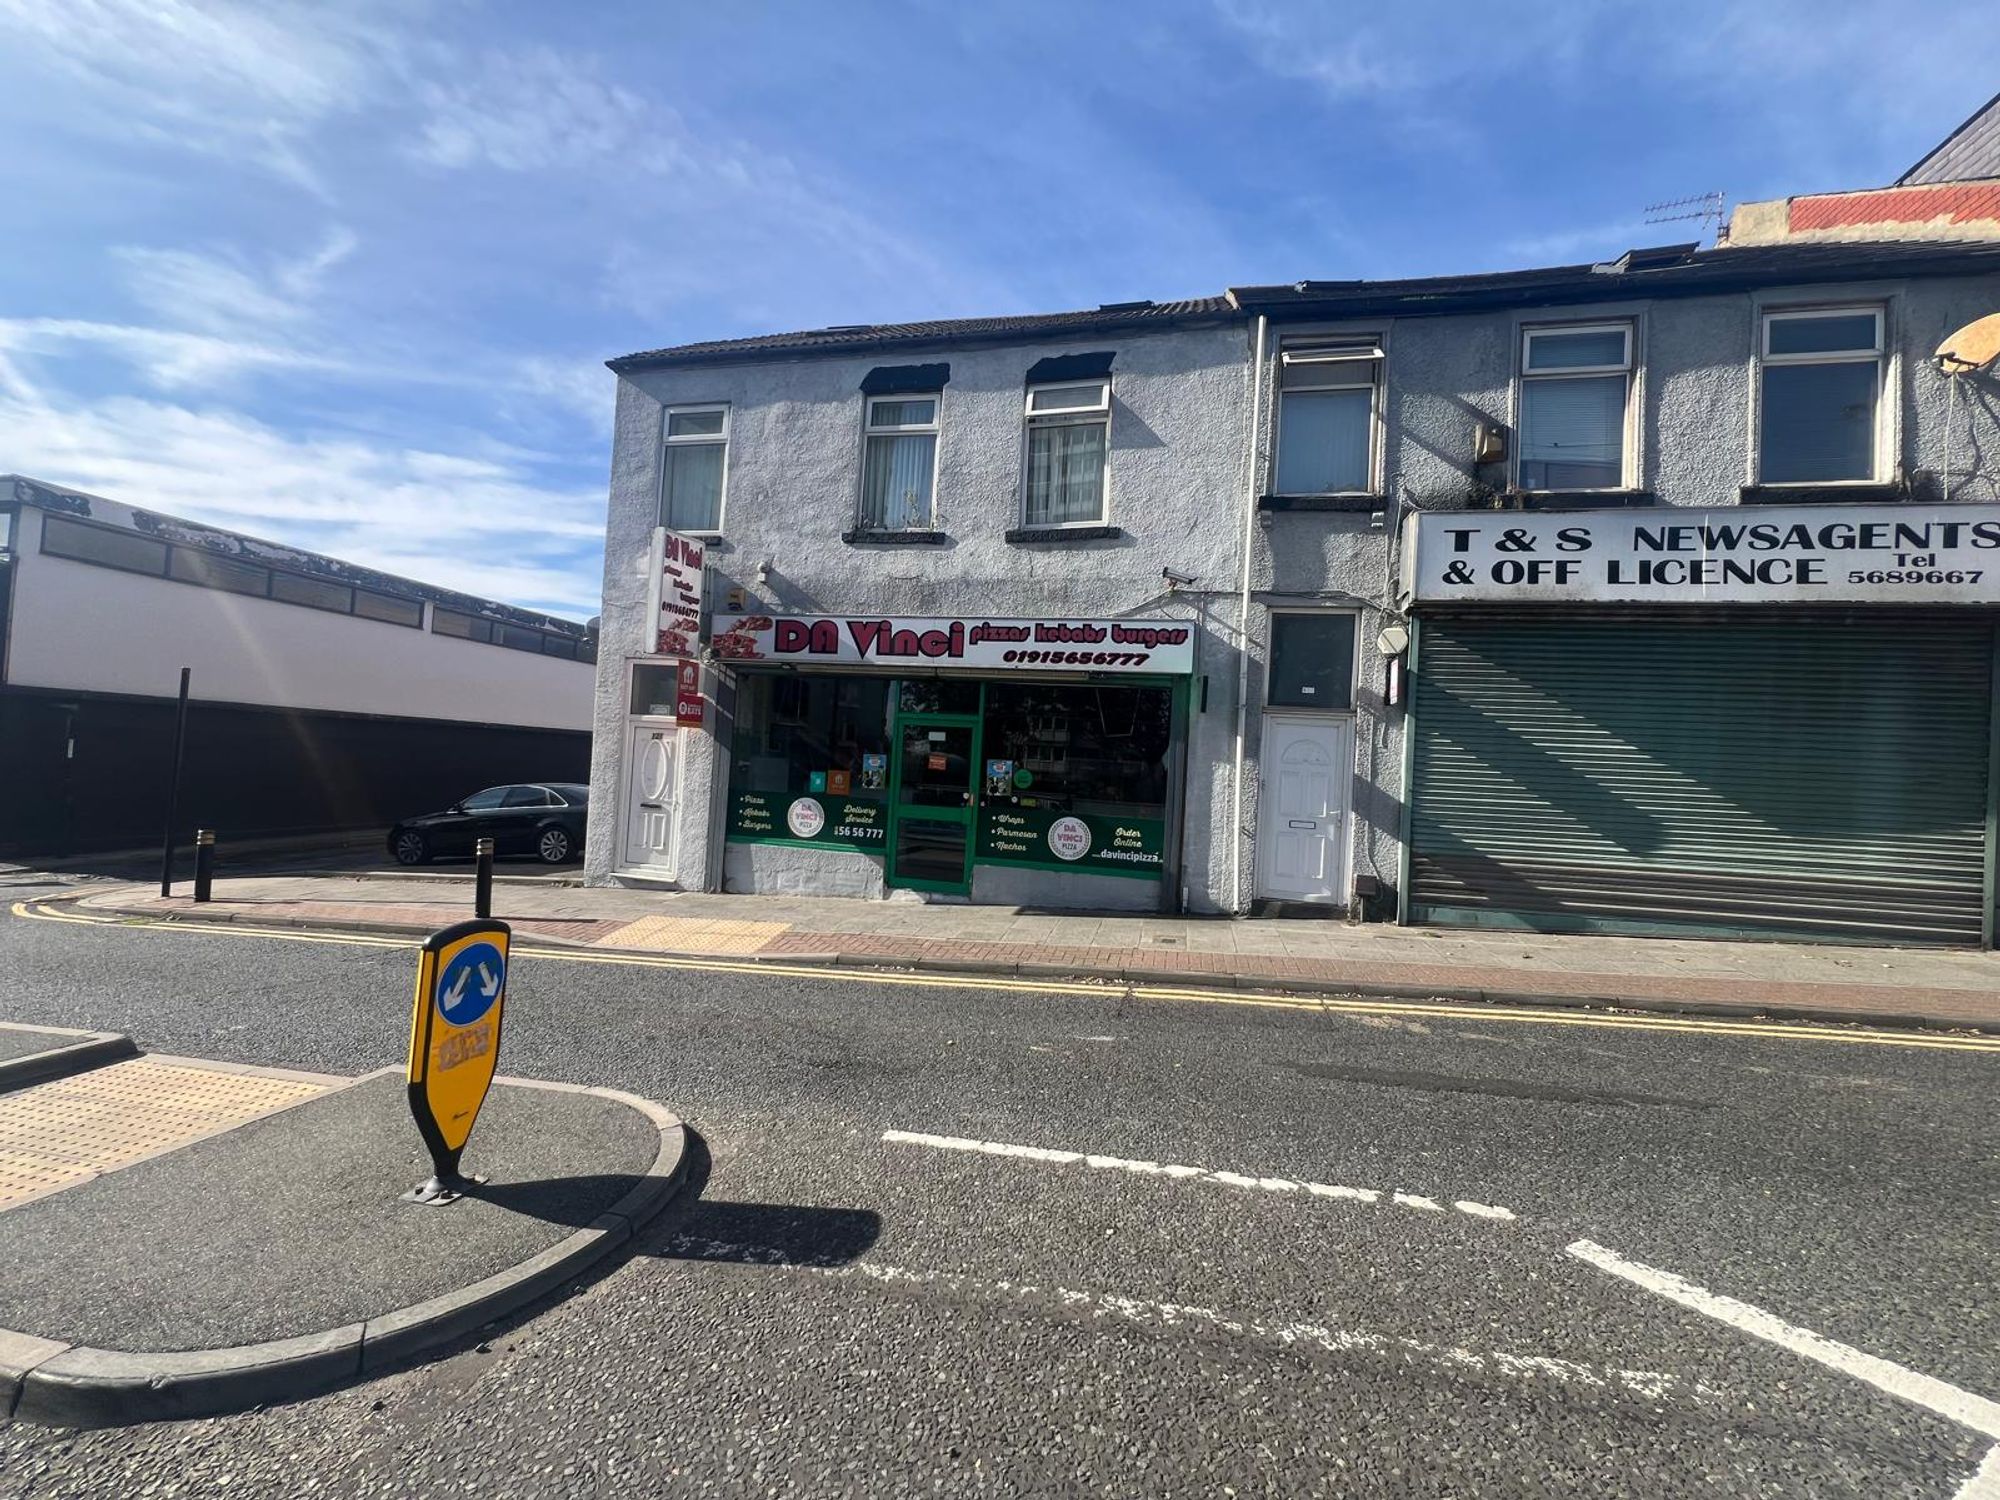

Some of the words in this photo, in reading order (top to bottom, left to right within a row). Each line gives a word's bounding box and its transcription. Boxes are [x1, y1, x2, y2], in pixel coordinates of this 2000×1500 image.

[1443, 529, 1481, 552] T
[1495, 528, 1537, 552] &
[1555, 528, 1592, 551] S
[1634, 522, 2000, 551] NEWSAGENTS
[1892, 553, 1935, 568] Tel
[1442, 559, 1475, 585] &
[1491, 559, 1582, 585] OFF
[1607, 558, 1828, 585] LICENCE
[1848, 570, 1984, 584] 5689667
[774, 619, 838, 654] DA
[846, 619, 965, 660] Vinci
[969, 622, 1030, 645] pizzas
[1034, 623, 1107, 643] kebabs
[1111, 624, 1188, 649] burgers
[1003, 650, 1150, 666] 01915656777
[843, 804, 877, 816] Delivery
[839, 826, 850, 836] 56
[852, 827, 864, 837] 56
[866, 829, 883, 839] 777
[1063, 823, 1077, 833] DA
[1115, 827, 1142, 838] Order
[1056, 832, 1083, 843] VINCI
[1113, 837, 1143, 848] Online
